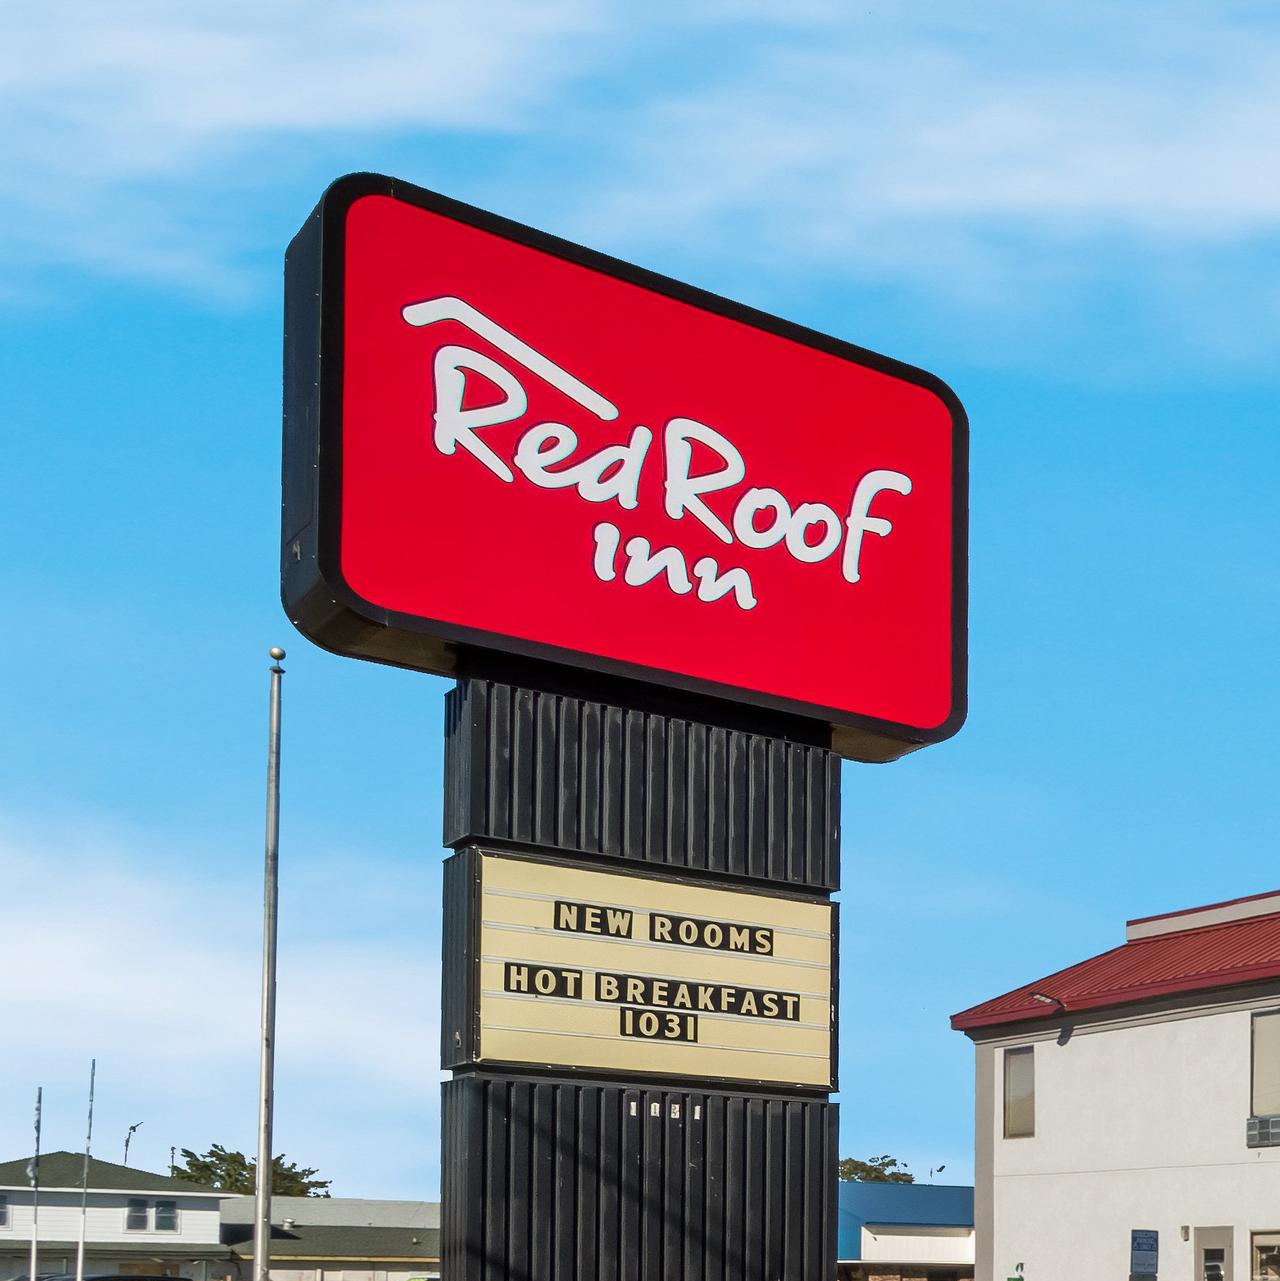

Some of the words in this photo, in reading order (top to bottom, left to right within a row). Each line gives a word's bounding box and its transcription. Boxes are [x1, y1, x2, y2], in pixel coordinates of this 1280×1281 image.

[433, 345, 653, 510] Red
[664, 417, 913, 584] Roof
[559, 903, 632, 937] NEW
[654, 916, 773, 954] ROOMS
[509, 965, 581, 998] HOT
[600, 975, 799, 1020] BREAKFAST
[625, 1009, 695, 1041] 1031
